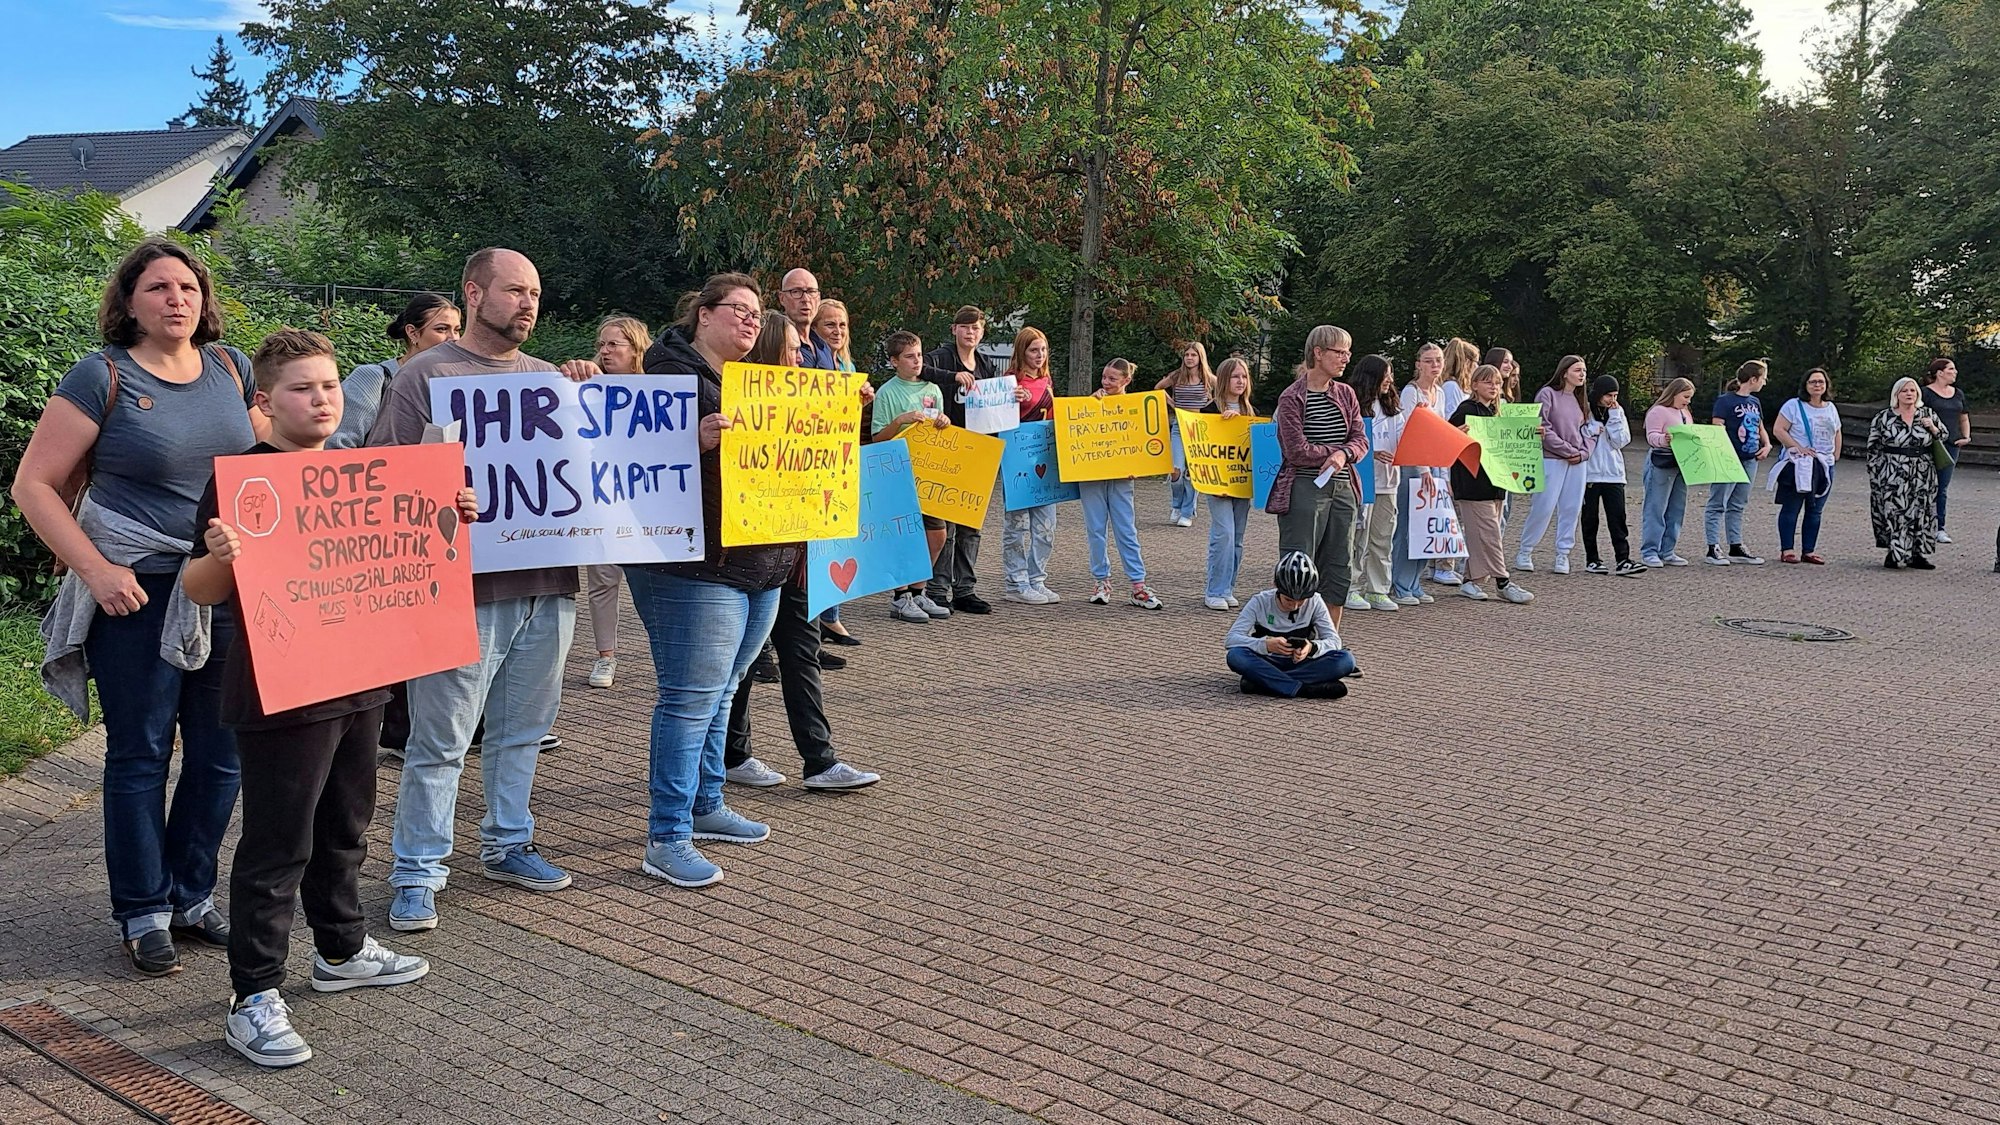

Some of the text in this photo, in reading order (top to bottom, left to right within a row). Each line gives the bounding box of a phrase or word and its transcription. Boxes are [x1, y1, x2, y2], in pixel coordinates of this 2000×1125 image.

[743, 370, 851, 398] IHR SPART
[451, 383, 696, 450] IHR SPART
[731, 404, 777, 432] AUF
[1068, 404, 1124, 420] Lieber heute
[1070, 440, 1085, 451] als
[1188, 444, 1250, 462] BRAUCHEN
[302, 459, 387, 500] ROTE
[464, 458, 692, 522] UNS KAPUTT
[243, 493, 267, 513] STOP
[295, 489, 437, 534] KARTE FÜR
[642, 526, 683, 536] BLEIBEN
[319, 600, 347, 616] MUSS
